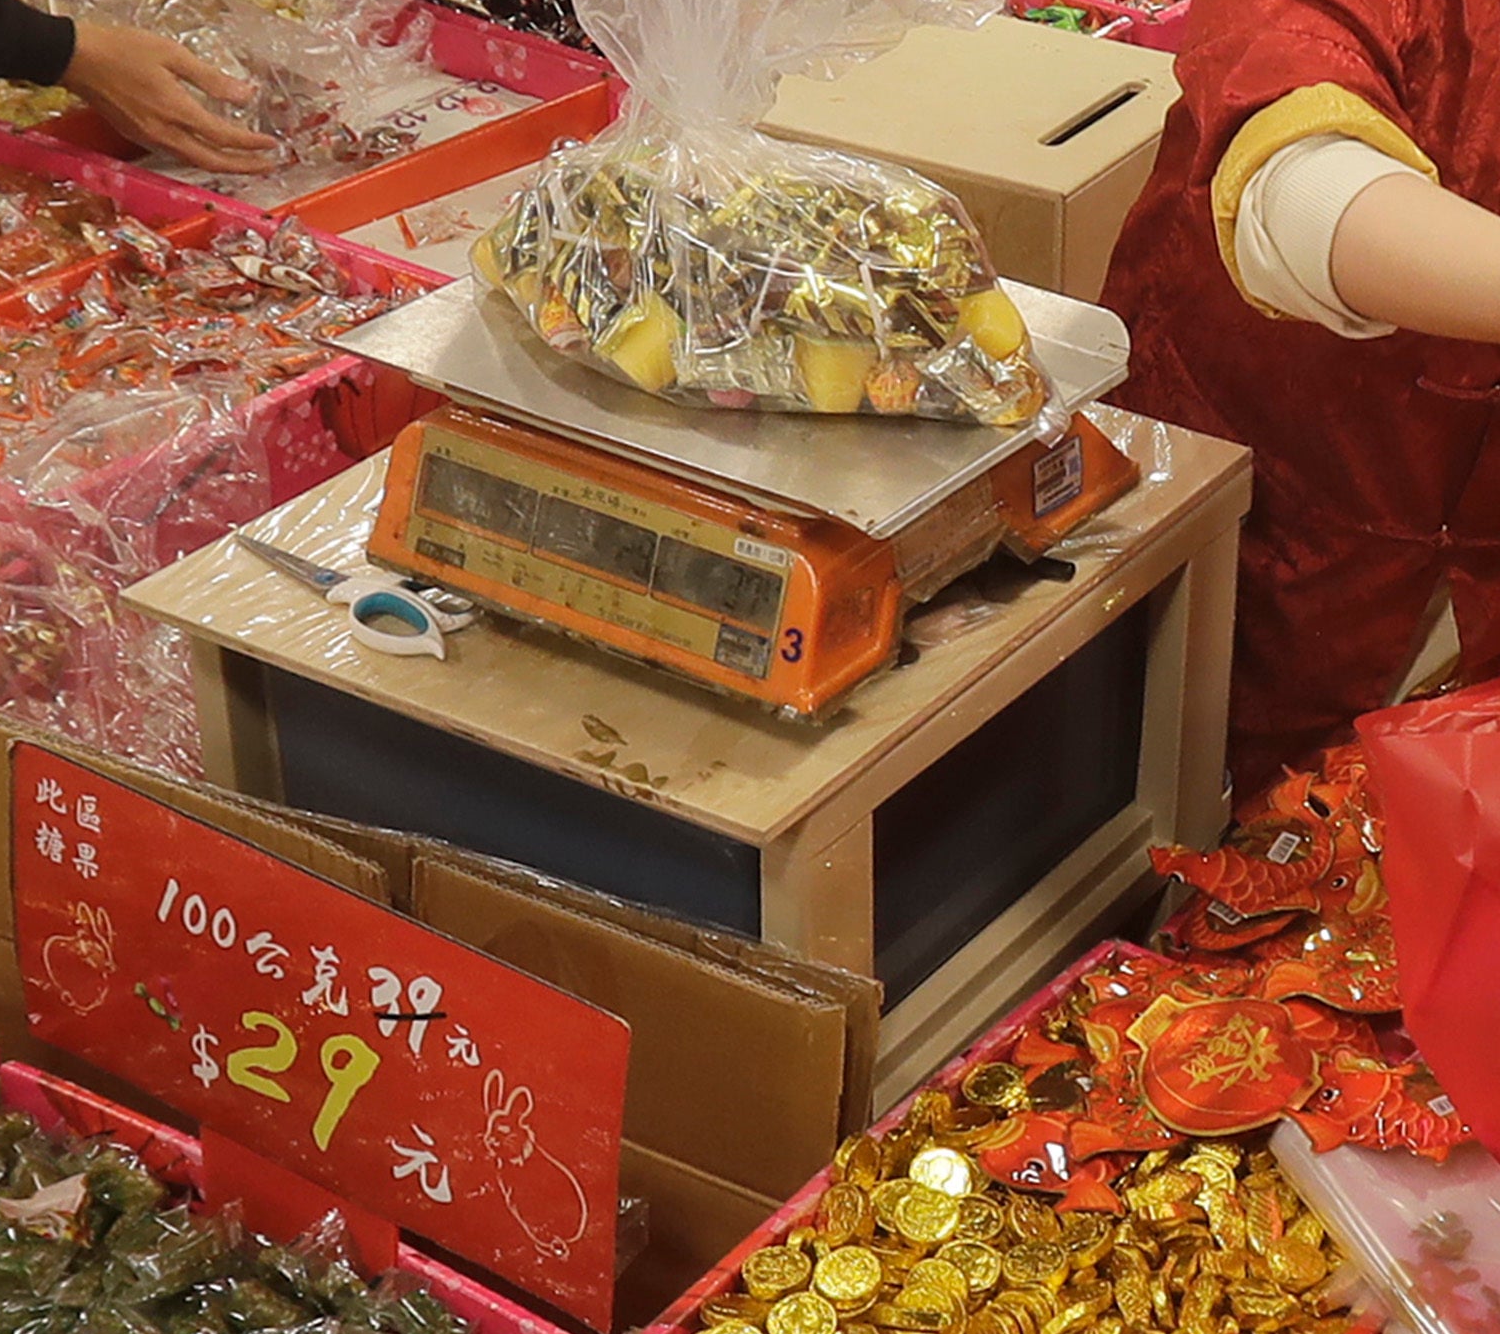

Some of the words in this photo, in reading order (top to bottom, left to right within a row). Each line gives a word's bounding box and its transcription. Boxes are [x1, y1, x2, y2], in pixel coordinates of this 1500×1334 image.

[780, 627, 804, 663] 3
[34, 776, 103, 835] 此區
[34, 821, 101, 880] 糖果
[190, 1009, 381, 1153] $29
[390, 1123, 453, 1204] 元
